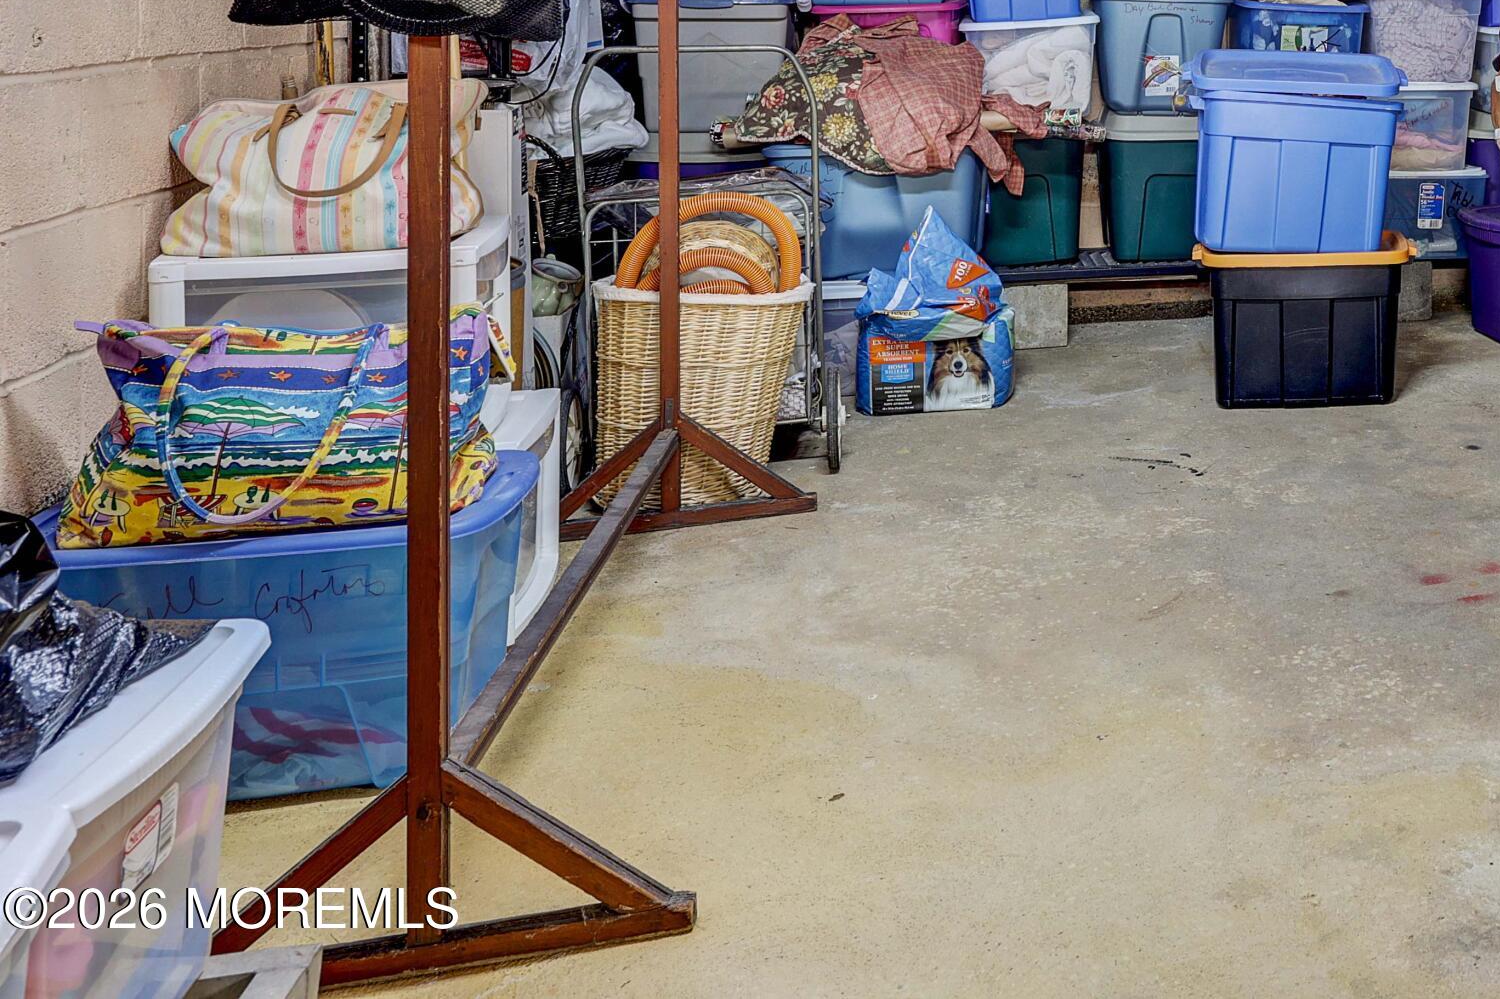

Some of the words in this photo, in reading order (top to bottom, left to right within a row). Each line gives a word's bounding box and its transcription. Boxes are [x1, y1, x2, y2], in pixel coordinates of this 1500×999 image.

[954, 261, 968, 281] 100
[886, 343, 910, 351] SUPER
[876, 349, 920, 358] ABSORBENT
